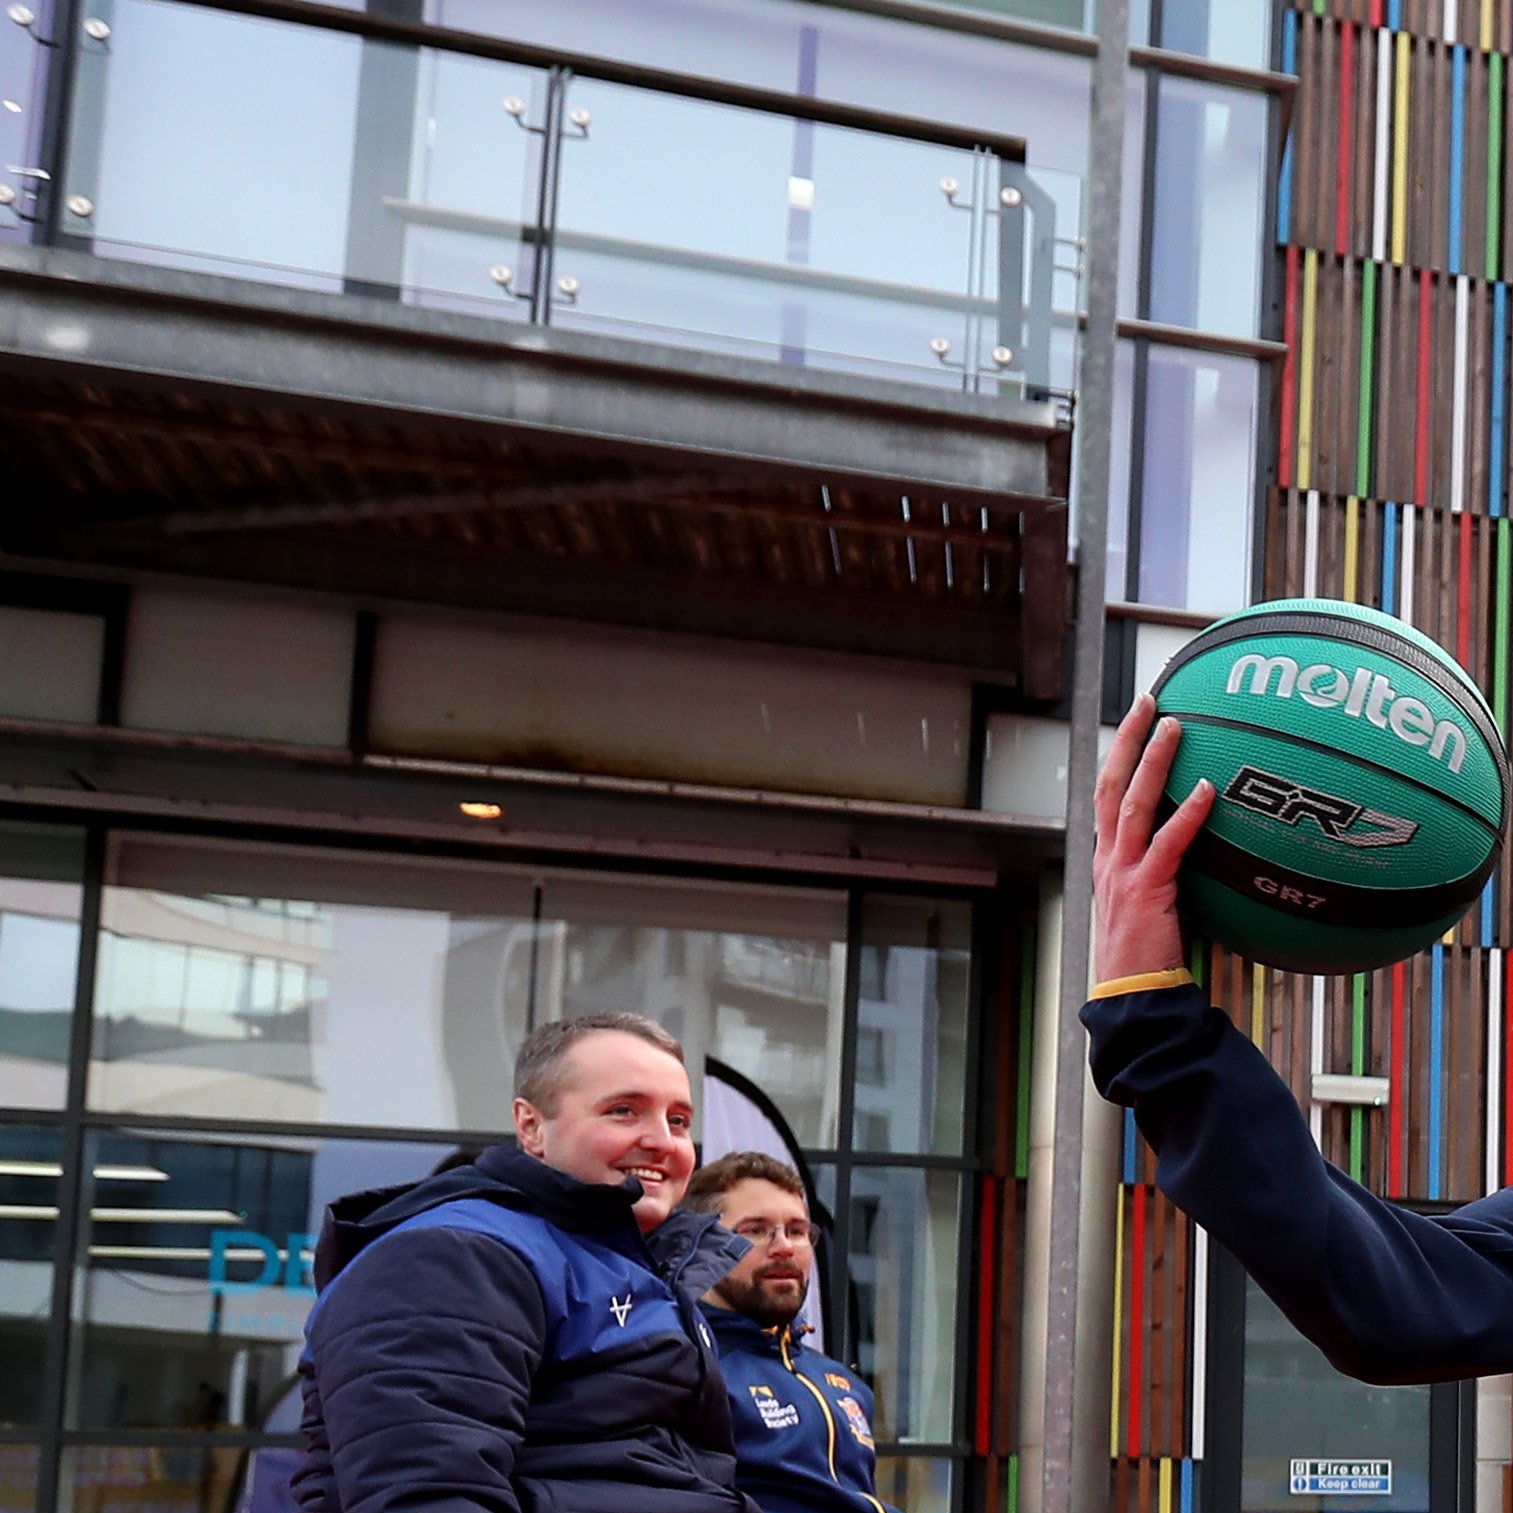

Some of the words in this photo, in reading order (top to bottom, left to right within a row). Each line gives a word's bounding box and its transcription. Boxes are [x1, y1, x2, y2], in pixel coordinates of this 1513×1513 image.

[1226, 653, 1467, 774] molten
[1253, 876, 1327, 909] GR7
[1318, 1462, 1348, 1475] Fire
[1351, 1462, 1380, 1475] exit
[1318, 1478, 1348, 1490] Keep
[1351, 1478, 1379, 1489] clear
